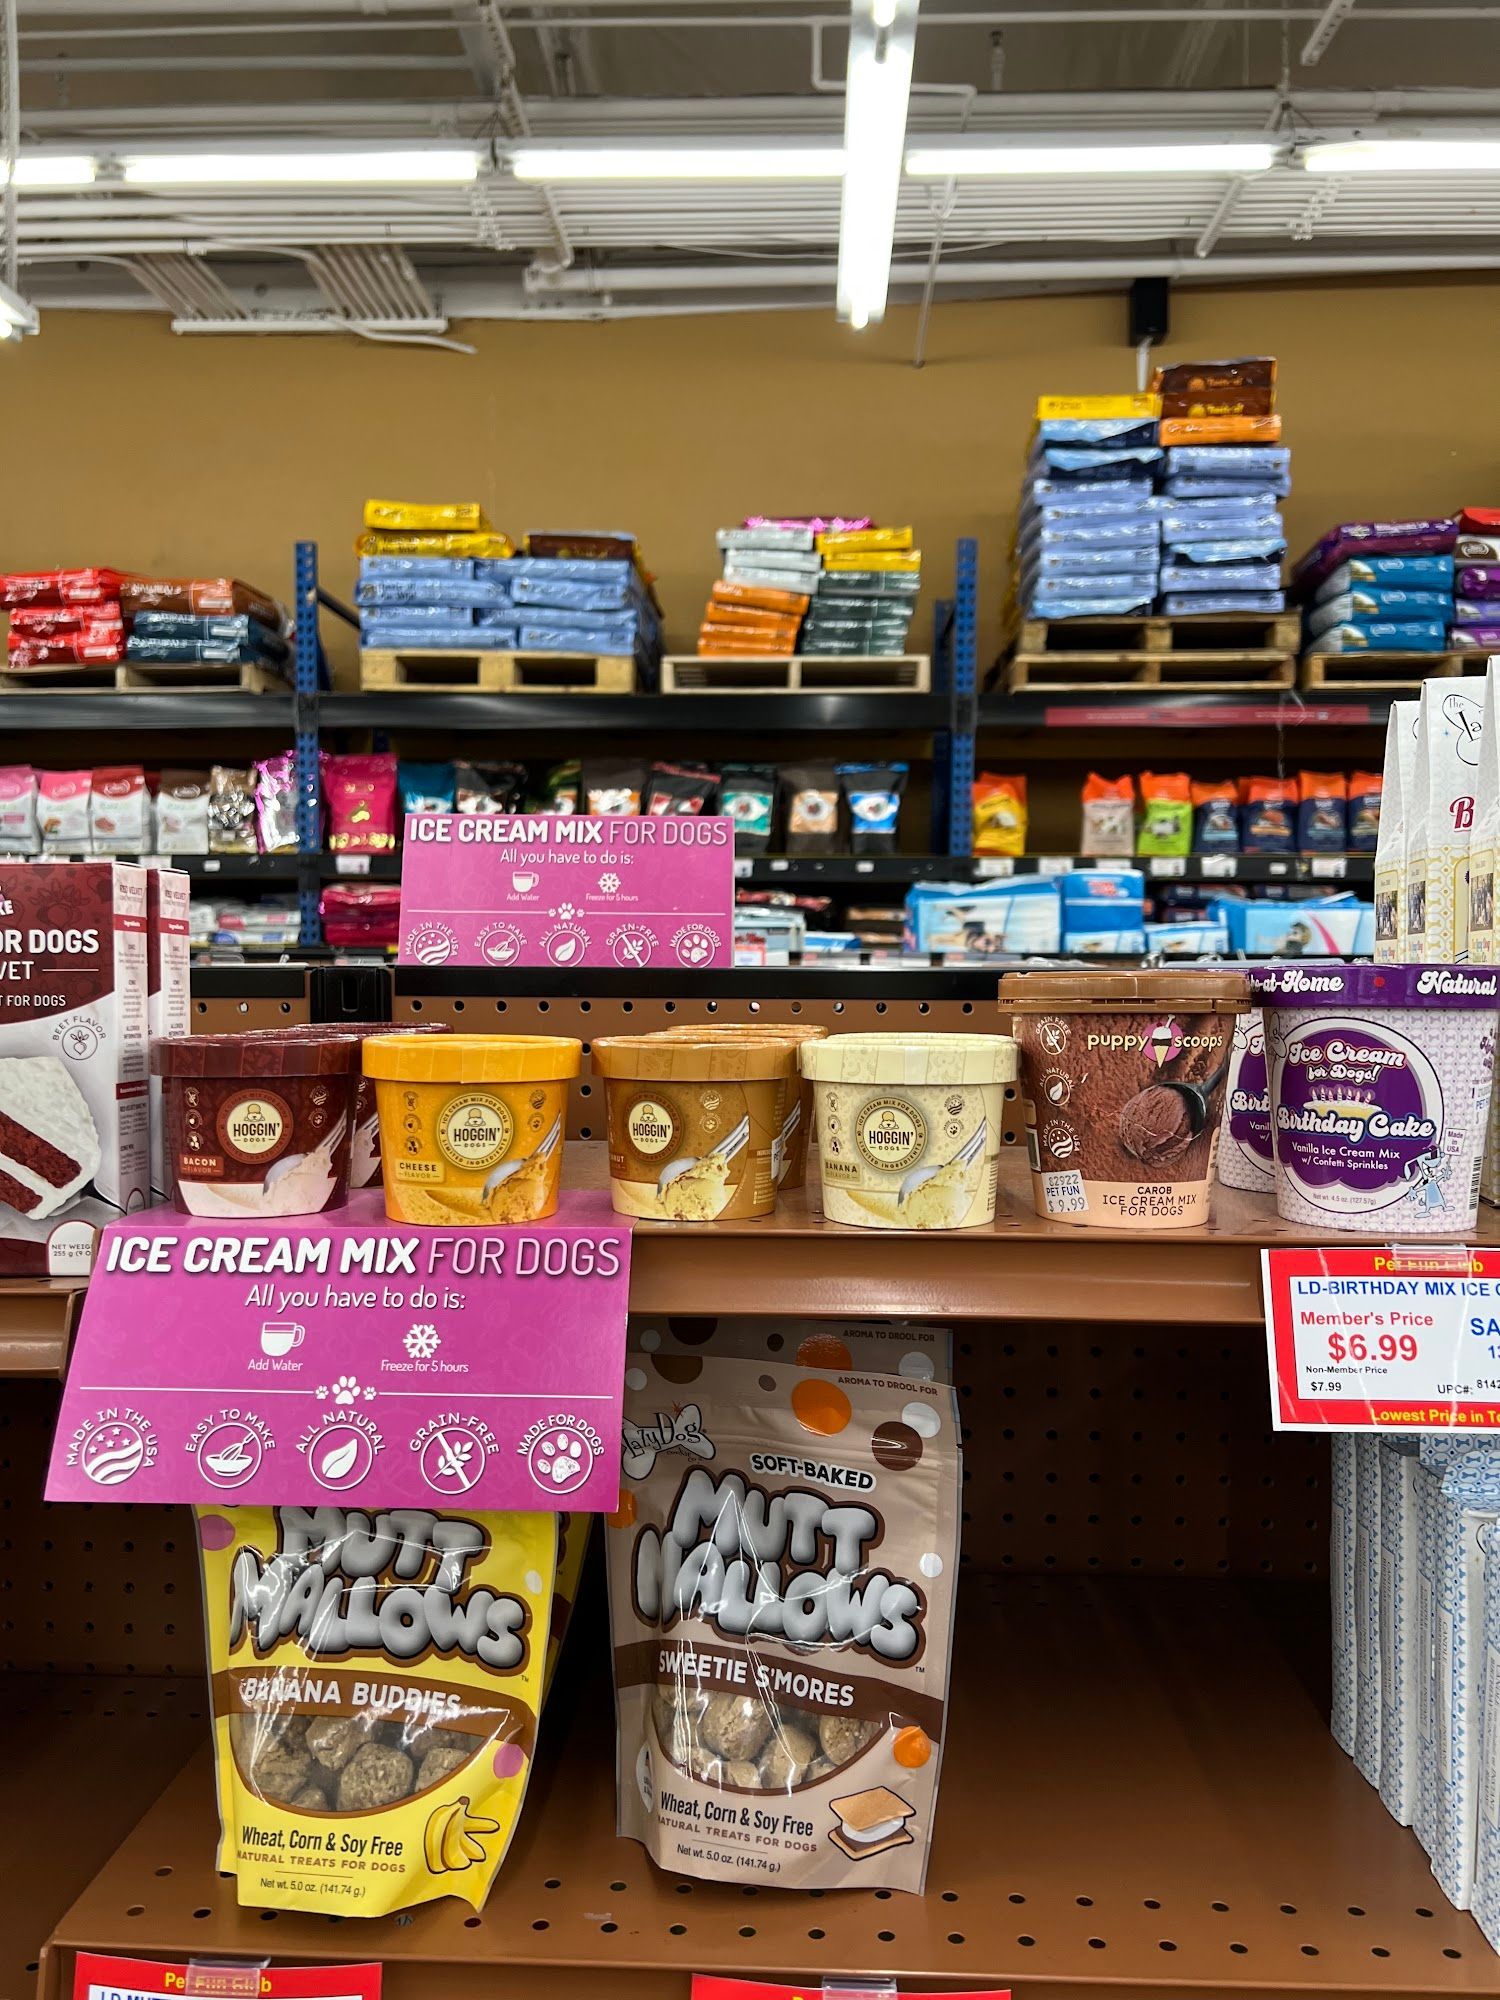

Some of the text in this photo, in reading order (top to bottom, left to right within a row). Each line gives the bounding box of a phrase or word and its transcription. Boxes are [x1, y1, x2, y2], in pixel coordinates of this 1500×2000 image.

[410, 818, 727, 846] ICE CREAM MIX FOR DOGS
[500, 850, 634, 866] All you have to do is:
[28, 929, 100, 954] DOGS
[474, 926, 491, 948] EASY
[508, 923, 528, 946] MAKE
[538, 922, 592, 948] ALL NATURAL
[605, 923, 660, 948] GRAIN-FREE
[669, 923, 722, 949] MADE FOR DOGS
[1416, 970, 1498, 996] Natural
[7, 994, 67, 1007] FOR DOGS
[52, 1015, 107, 1041] BEET FLAVOR
[1036, 1016, 1072, 1035] GRAIN FREE
[1087, 1033, 1223, 1054] puppy scoops
[1289, 1041, 1405, 1067] Ice Cream
[1307, 1065, 1381, 1083] for Dogs!
[233, 1122, 280, 1137] HOGGIN'
[453, 1127, 501, 1142] HOGGIN'
[632, 1123, 671, 1138] HOGGIN'
[1277, 1109, 1435, 1142] Birthday Cake
[869, 1130, 914, 1146] HOGGIN'
[183, 1157, 217, 1167] BACON
[859, 1141, 879, 1165] LIMITED
[1292, 1142, 1400, 1160] Vanilla Ice Cream Mix
[399, 1162, 437, 1172] CHEESE
[825, 1161, 858, 1174] BANANA
[1301, 1155, 1389, 1171] w/ Confetti Sprinkles
[1046, 1185, 1080, 1197] PET FUN
[1102, 1194, 1197, 1206] ICE CREAM MIX
[1137, 1186, 1172, 1195] CAROB
[1058, 1197, 1085, 1212] 9.99
[1120, 1206, 1184, 1216] FOR DOGS
[105, 1236, 621, 1277] ICE CREAM MIX FOR DOGS
[244, 1285, 466, 1313] All you have to do is:
[1297, 1280, 1419, 1296] LD-BIRTHDAY
[1425, 1282, 1457, 1296] MIX
[1462, 1282, 1491, 1296] ICE
[1300, 1311, 1434, 1327] Member's Price
[1328, 1332, 1418, 1364] $6.99
[247, 1359, 303, 1372] Add Water
[380, 1359, 470, 1373] Freeze for 5 hours
[1306, 1366, 1388, 1375] Non-Member Price
[838, 1376, 938, 1396] AROMA TO DROOL FOR
[1311, 1381, 1342, 1392] $7.99
[1437, 1384, 1474, 1395] UPC#:
[1371, 1408, 1425, 1422] Lowest
[1429, 1409, 1467, 1423] Price
[1470, 1409, 1484, 1423] in
[66, 1407, 158, 1468] MADE IN THE USA
[185, 1408, 276, 1452] EASY TO MAKE
[295, 1409, 386, 1455] ALL NATURAL
[409, 1412, 500, 1455] GRAIN-FREE
[516, 1413, 605, 1457] MADE FOR DOGS
[751, 1454, 874, 1490] SOFT-BAKED
[671, 1468, 877, 1576] MUTT
[279, 1504, 483, 1593] MUTT
[636, 1528, 918, 1660] MALLOWS
[229, 1548, 524, 1668] MALLOWS
[658, 1650, 855, 1708] SWEETIE S'MORES
[240, 1677, 462, 1719] BANANA BUDDIES
[660, 1791, 814, 1837] Wheat, Corn & Soy Free
[242, 1825, 403, 1857] Wheat, Corn & Soy Free
[706, 1826, 751, 1843] TREATS
[755, 1835, 780, 1847] FOR
[784, 1839, 818, 1852] DOGS
[290, 1855, 336, 1869] TREATS
[341, 1858, 366, 1871] FOR
[371, 1861, 406, 1874] DOGS
[677, 1843, 781, 1873] Net wt. 5.0 oz. (141.74 g.)
[260, 1878, 366, 1899] Net wt. 5.0 oz. (141.74 g.)
